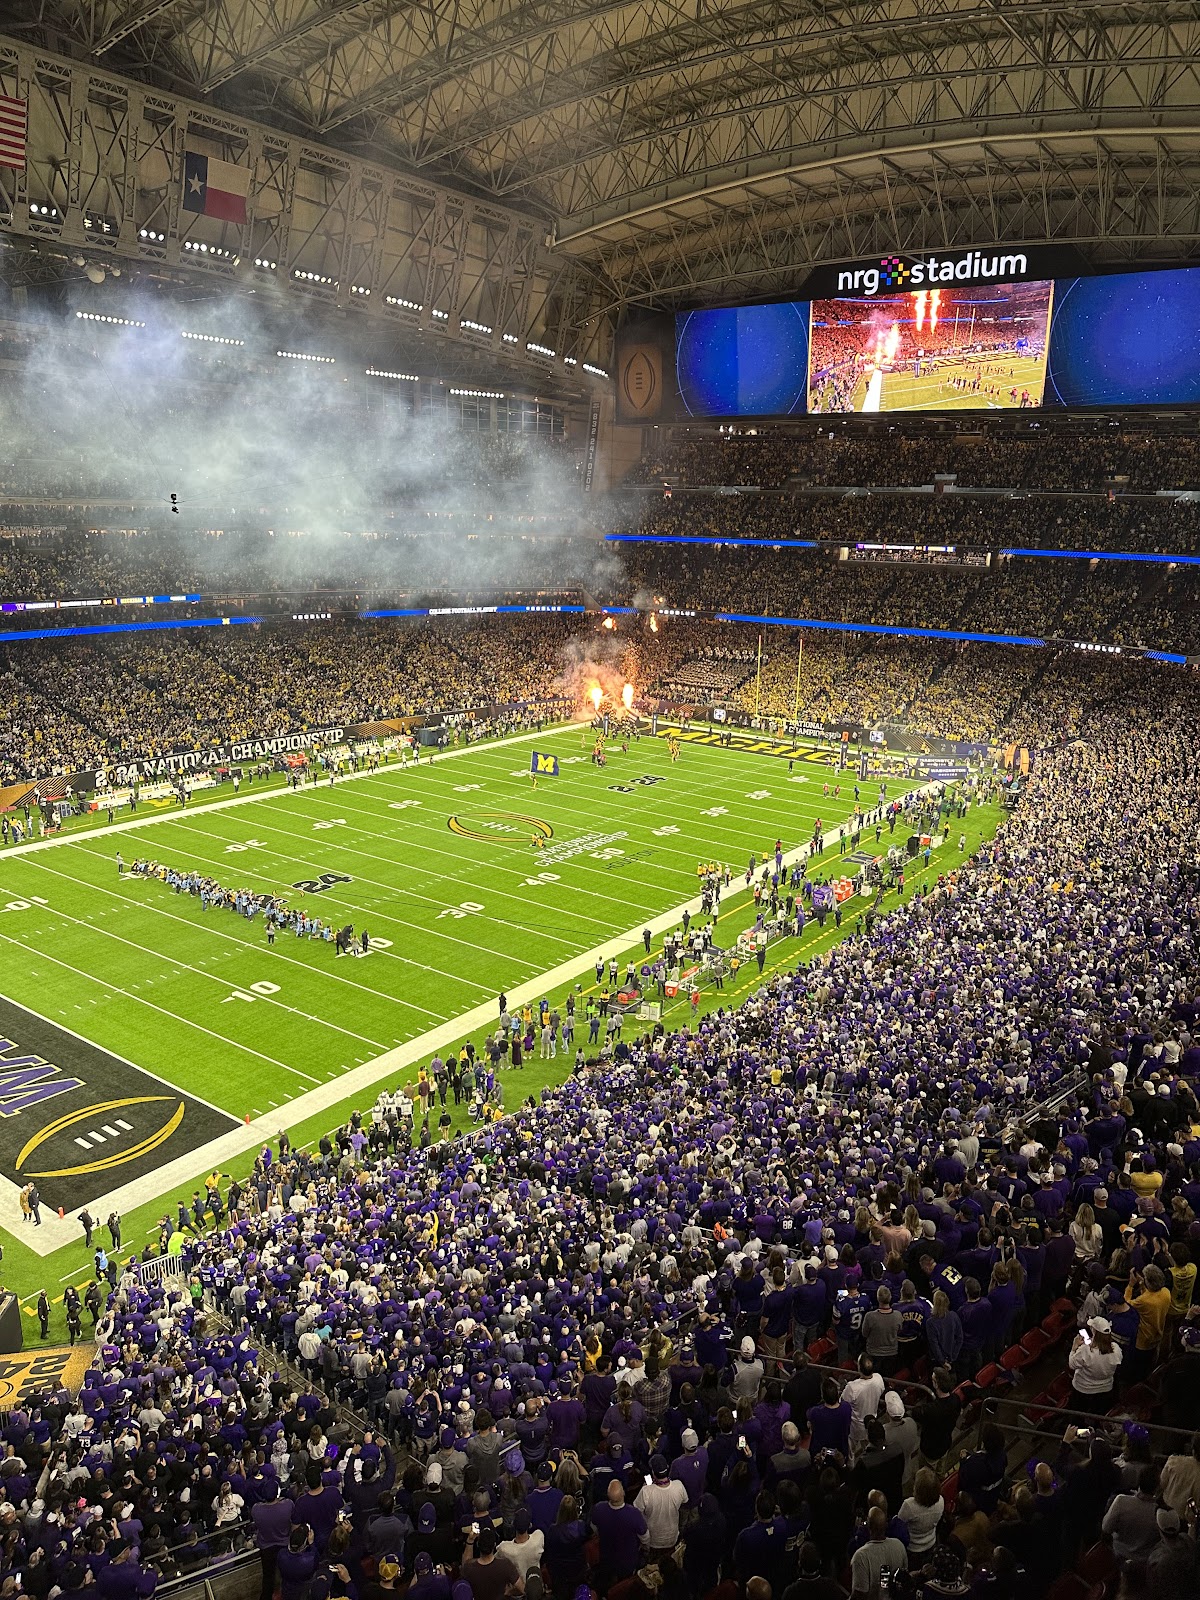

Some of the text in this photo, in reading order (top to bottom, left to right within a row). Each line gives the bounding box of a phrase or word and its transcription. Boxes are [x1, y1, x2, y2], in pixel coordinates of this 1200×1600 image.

[838, 252, 1027, 295] nrg stadium
[232, 728, 344, 761] CHAMPIONSHIP
[537, 754, 555, 773] M
[533, 830, 629, 867] CHAMPIONSHIP
[589, 847, 625, 860] 50
[525, 872, 561, 886] 40
[440, 901, 486, 919] 30
[231, 980, 282, 1003] 10
[1008, 1184, 1015, 1199] 1
[850, 1312, 862, 1330] 9
[79, 1438, 91, 1448] 73
